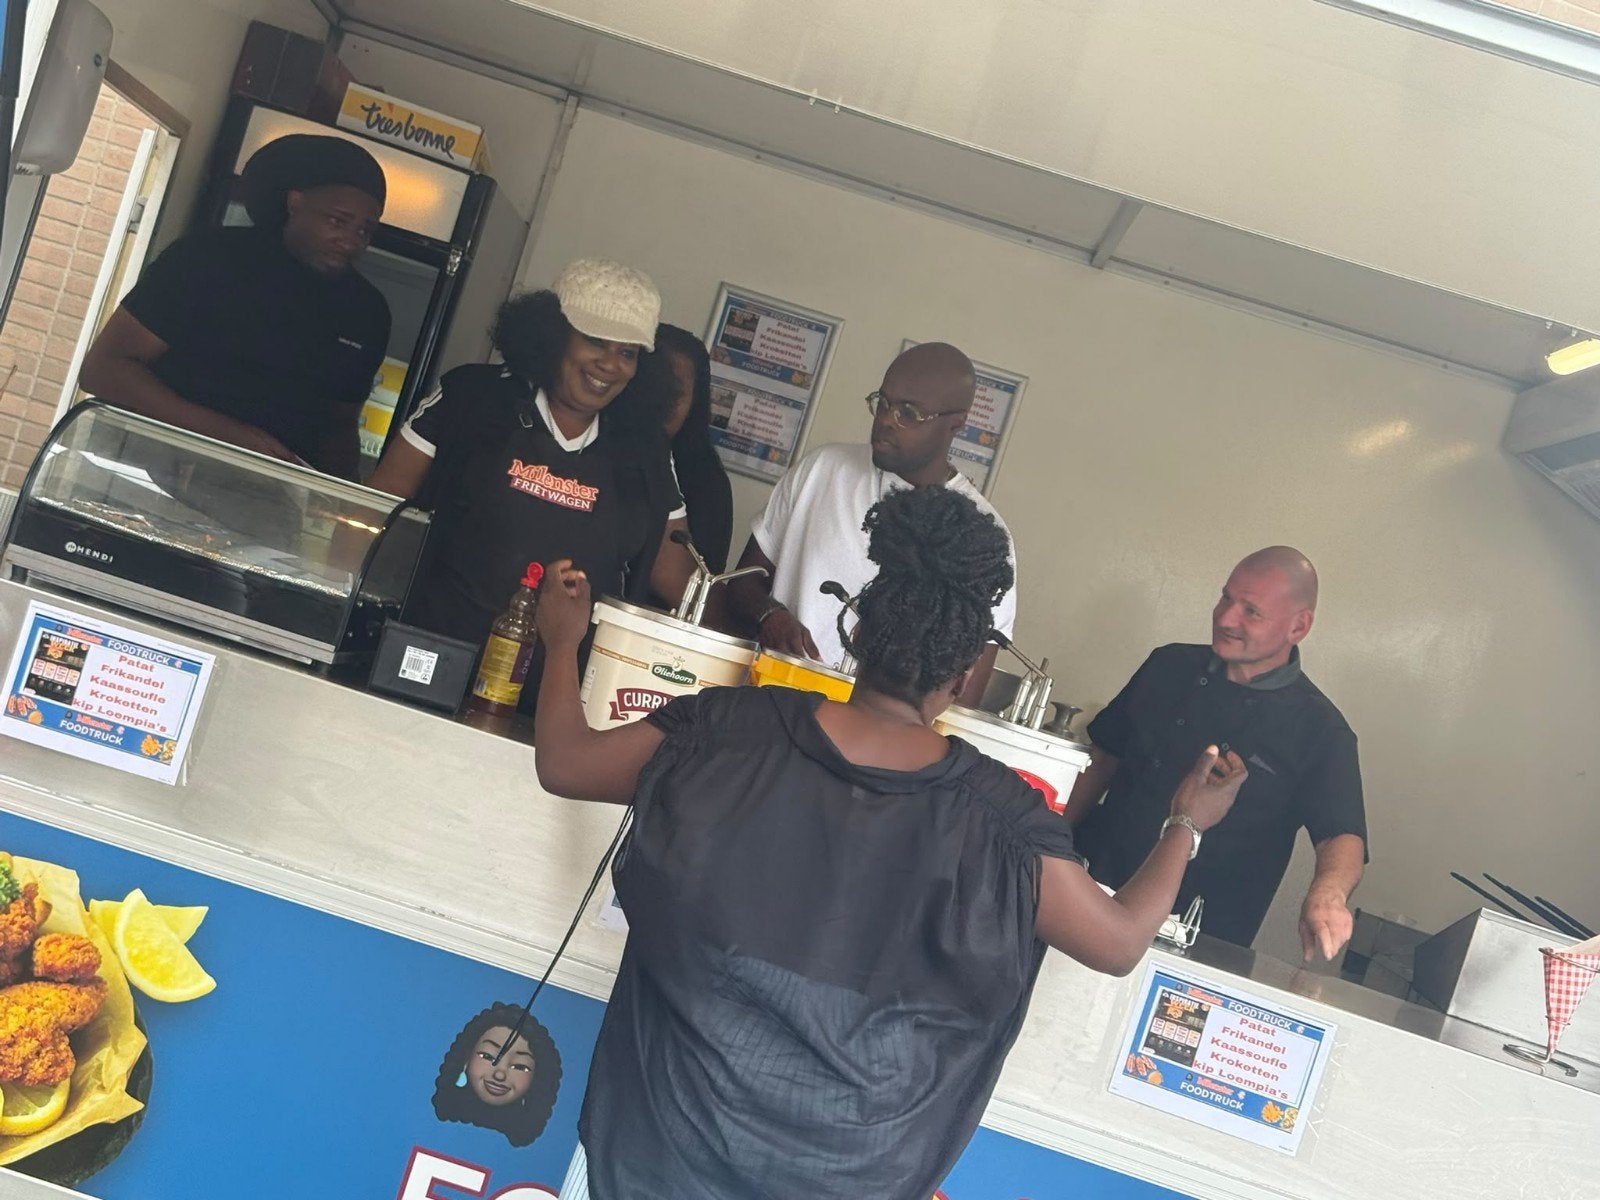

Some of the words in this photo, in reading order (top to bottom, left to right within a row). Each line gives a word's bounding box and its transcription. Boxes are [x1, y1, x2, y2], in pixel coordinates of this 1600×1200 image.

[507, 459, 599, 502] Milenster
[514, 478, 591, 509] FRIETWAGEN
[77, 545, 114, 563] HENDI
[107, 639, 171, 666] FOODTRUCK
[118, 655, 154, 673] Patat
[89, 675, 167, 704] Kaassoufle
[100, 664, 165, 690] Frikandel
[73, 698, 94, 712] kip
[97, 705, 167, 733] Loempia's
[89, 689, 158, 716] Kroketten
[59, 720, 124, 746] FOODTRUCK
[1227, 1001, 1293, 1031] FOODTRUCK
[1239, 1017, 1277, 1037] Patat
[1210, 1036, 1288, 1070] Kaassoufle
[1221, 1026, 1286, 1055] Frikandel
[1194, 1059, 1214, 1075] kip
[1218, 1069, 1289, 1100] Loempia's
[1210, 1051, 1279, 1082] Kroketten
[1180, 1082, 1245, 1111] FOODTRUCK
